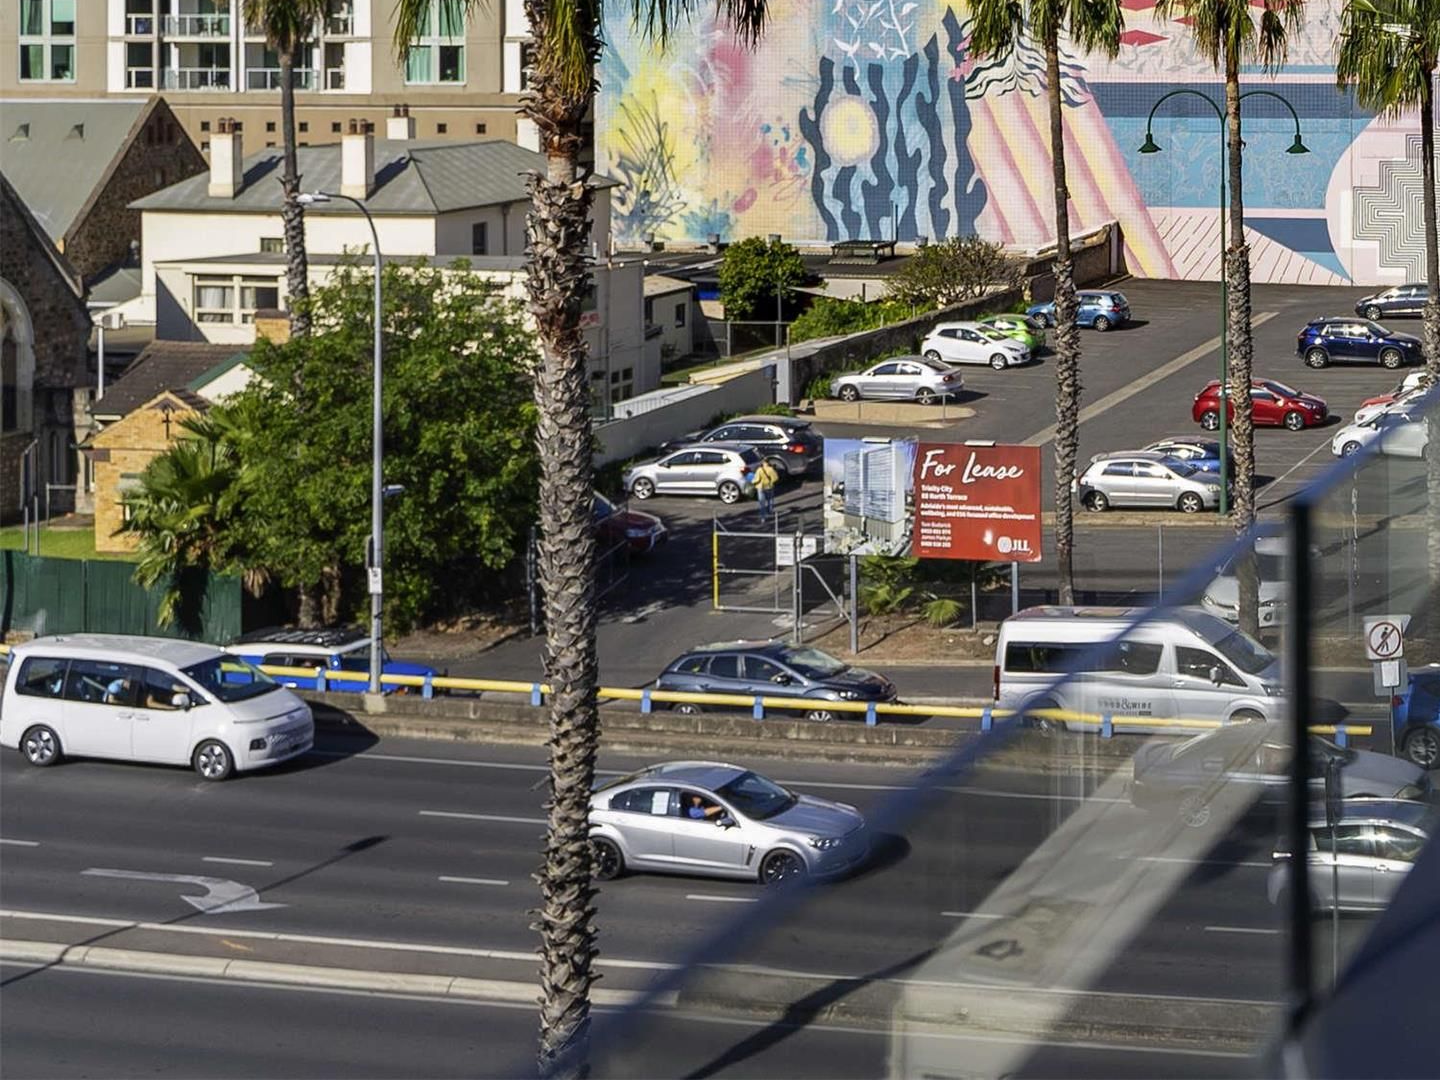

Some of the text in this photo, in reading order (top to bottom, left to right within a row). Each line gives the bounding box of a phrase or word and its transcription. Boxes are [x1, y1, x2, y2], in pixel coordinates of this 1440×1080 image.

[920, 449, 1024, 483] For Lease
[1011, 539, 1031, 551] JLL
